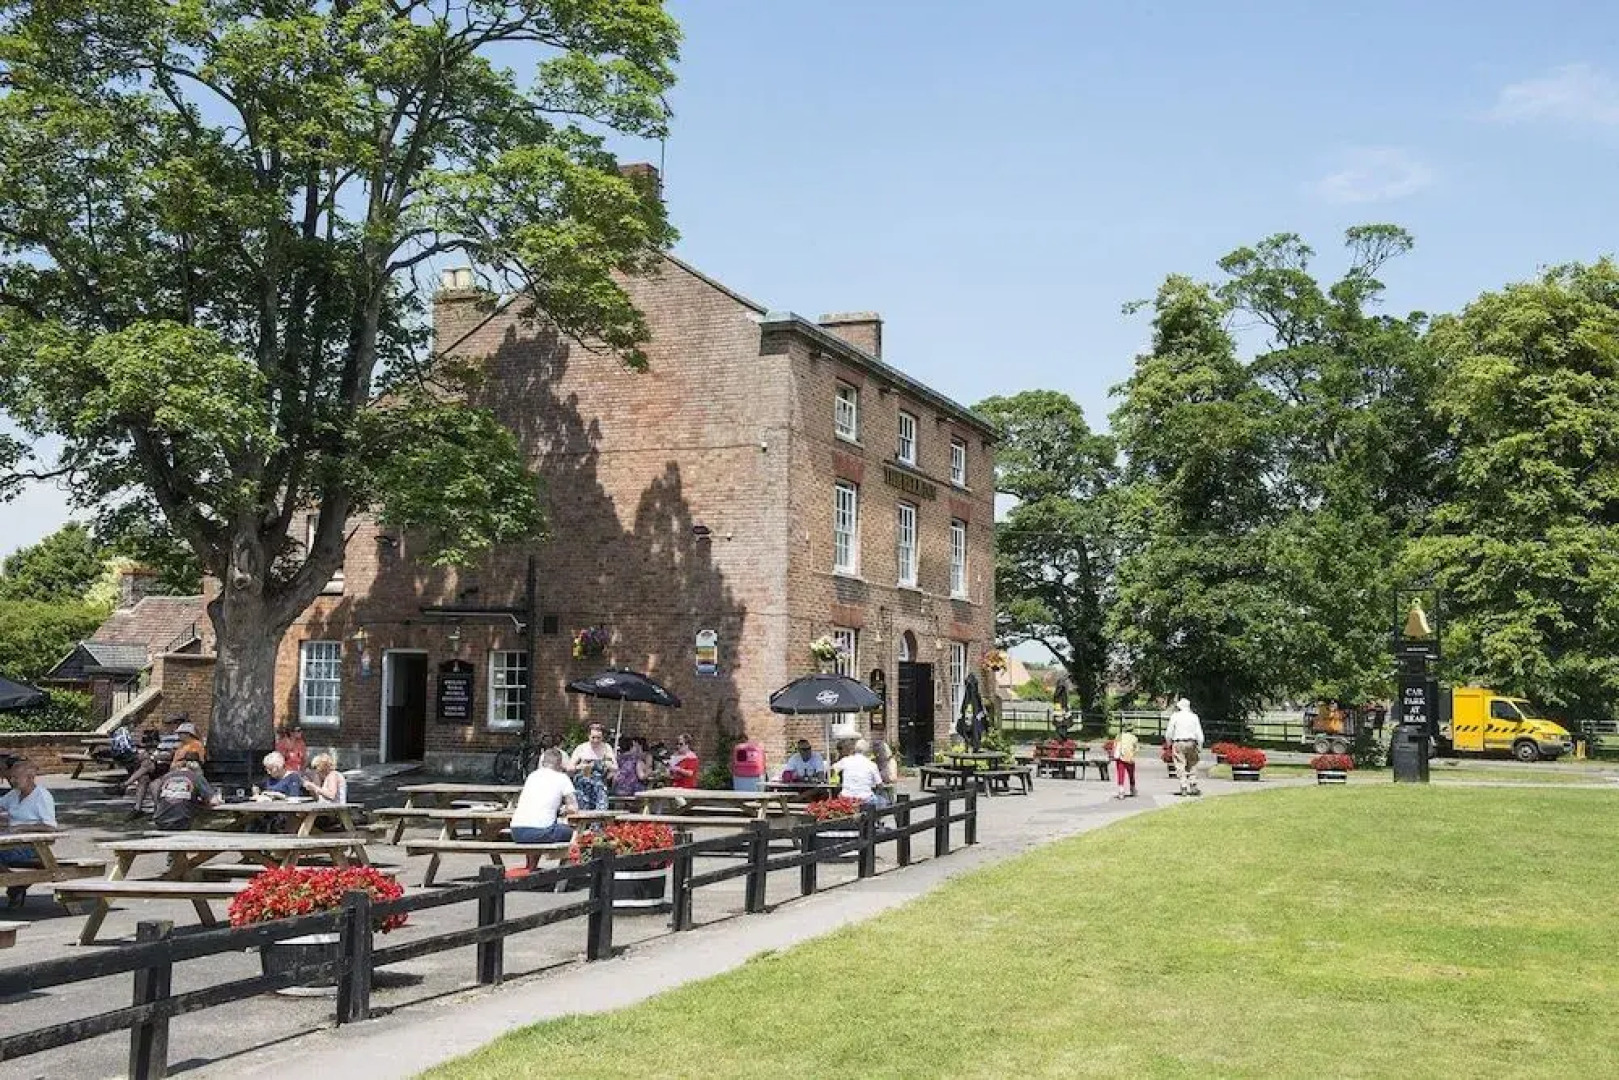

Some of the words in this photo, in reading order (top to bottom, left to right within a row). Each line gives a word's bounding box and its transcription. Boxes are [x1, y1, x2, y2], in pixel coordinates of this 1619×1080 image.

[1405, 687, 1424, 697] CAR
[1403, 697, 1426, 705] PARK
[1410, 705, 1421, 714] AT
[1403, 714, 1427, 723] REAR
